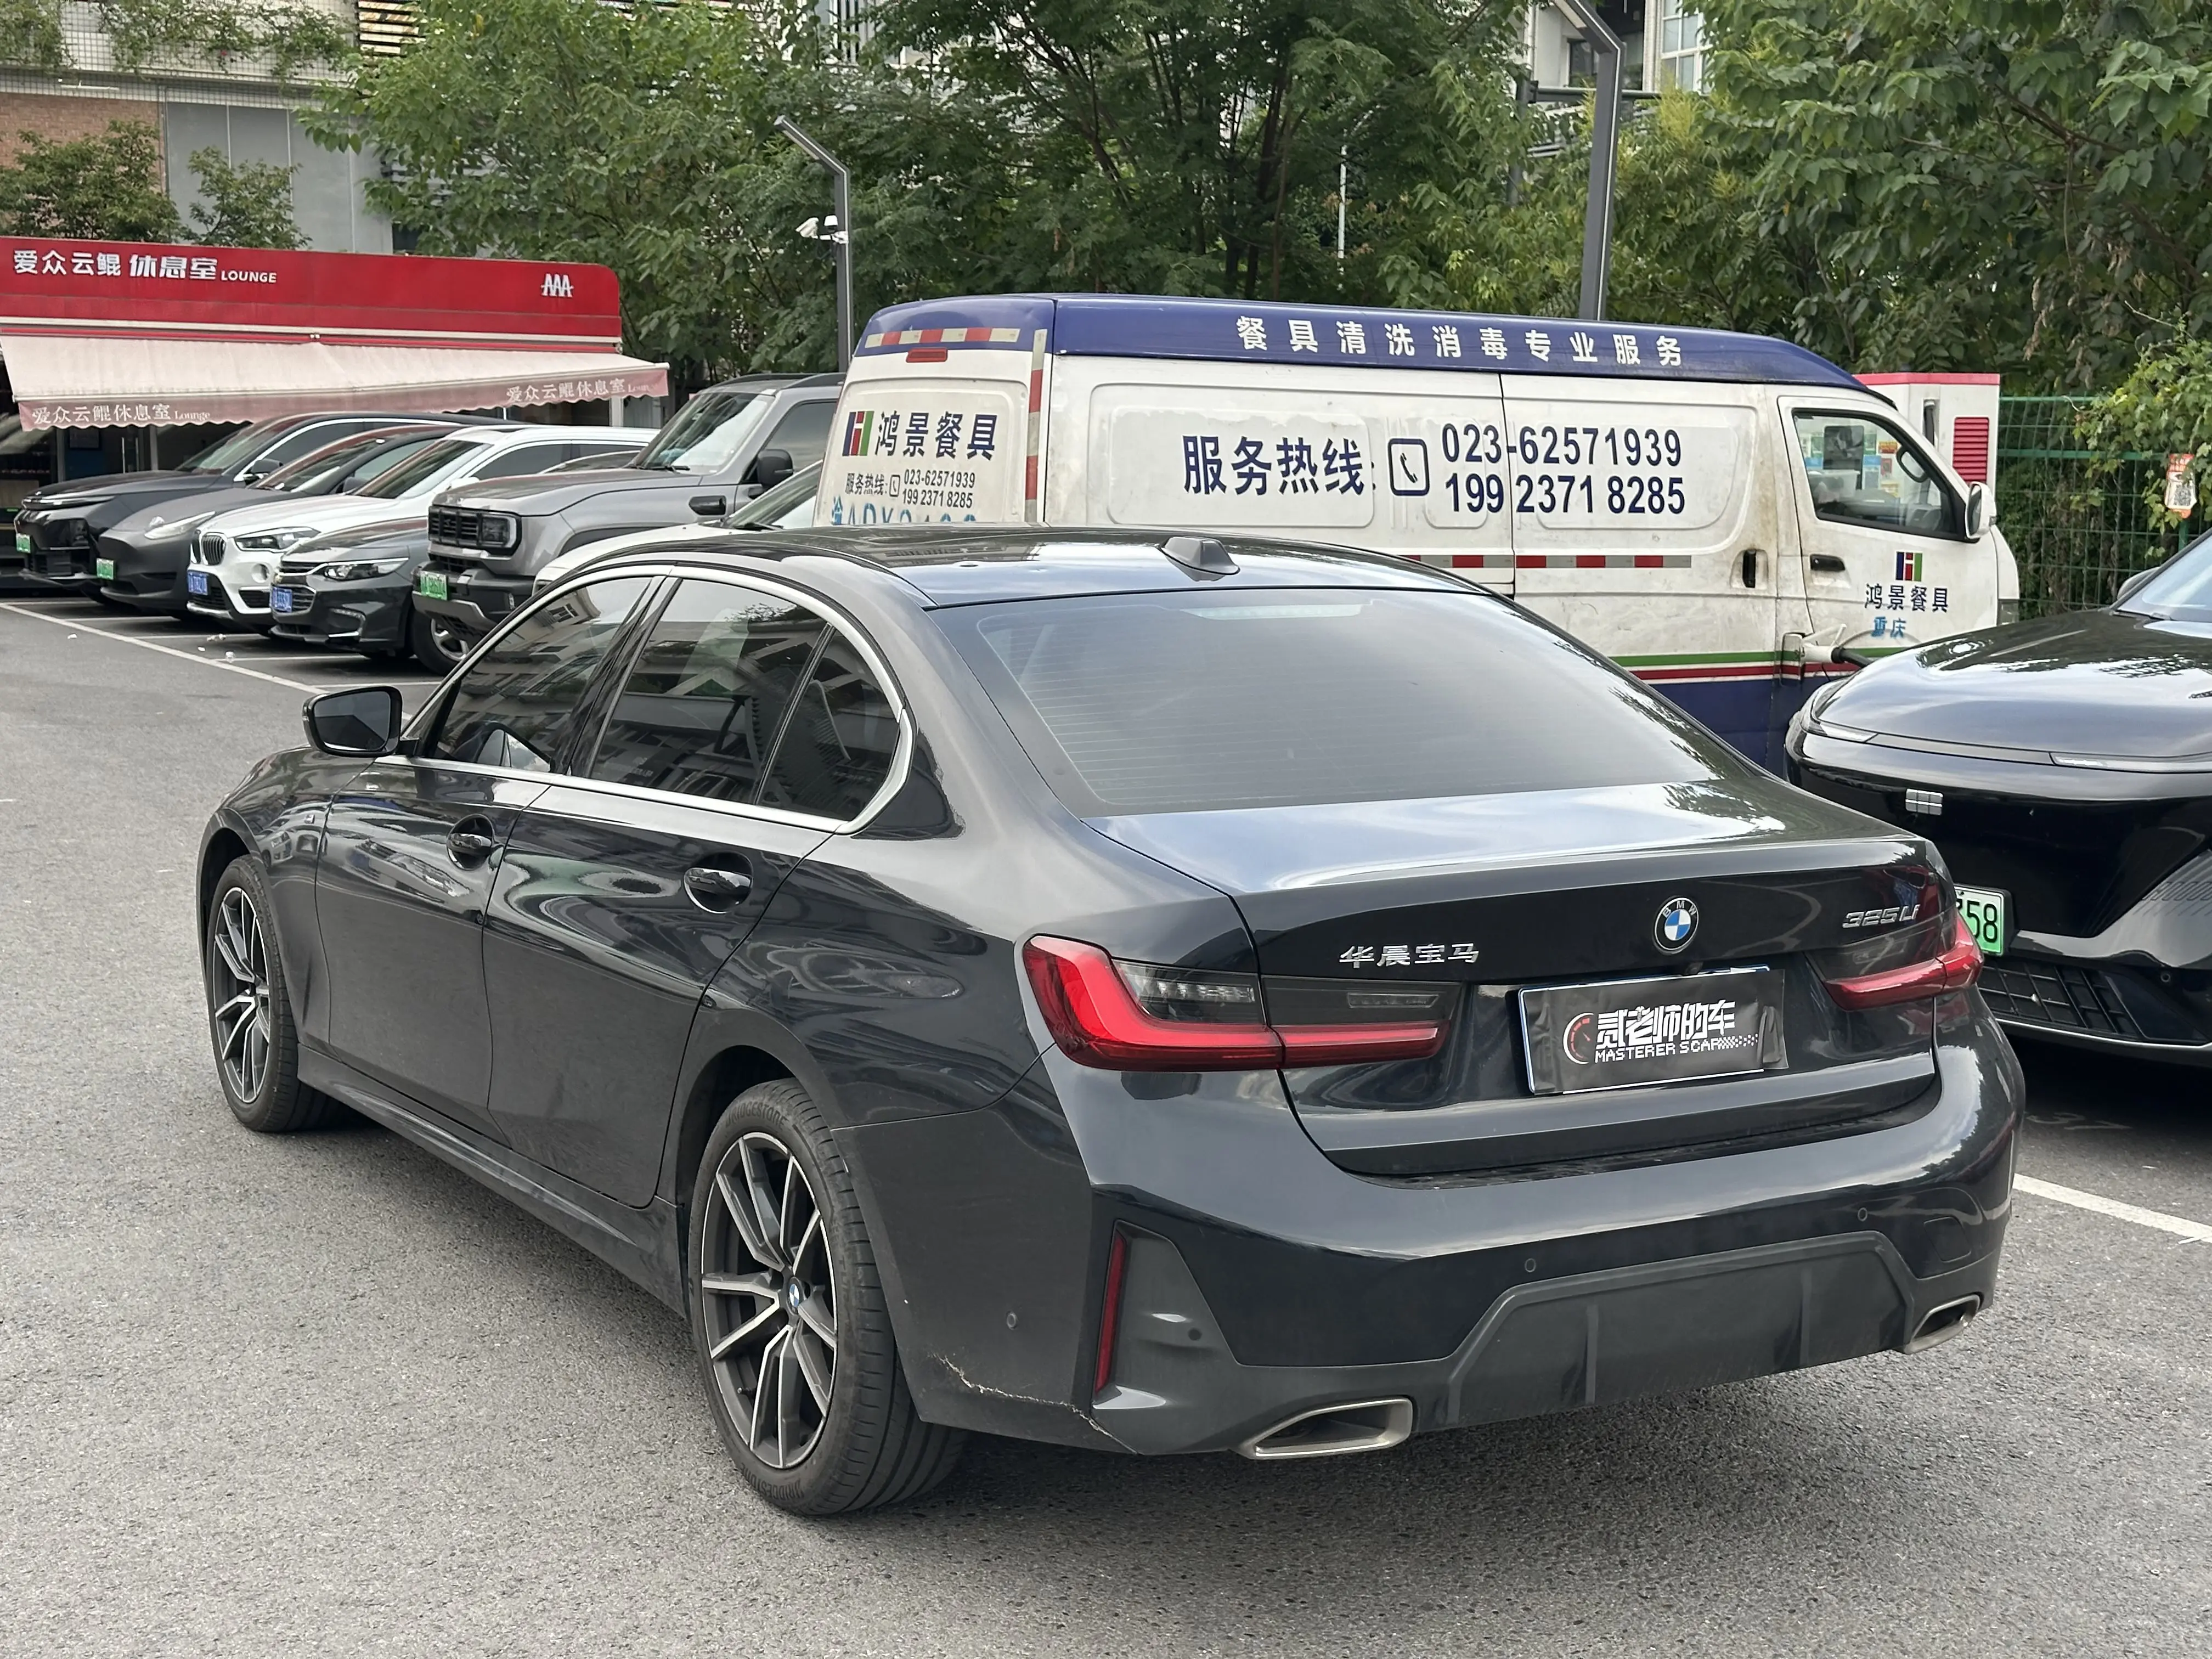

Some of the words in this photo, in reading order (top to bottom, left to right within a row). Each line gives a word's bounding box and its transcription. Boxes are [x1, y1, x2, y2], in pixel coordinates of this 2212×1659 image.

[14, 250, 121, 276] 爱众云鲲
[129, 254, 217, 280] 休息室
[221, 270, 276, 283] LOUNGE
[1236, 316, 1682, 367] 餐具清洗消毒专业服务
[174, 410, 211, 422] Lounge
[875, 410, 997, 460] 鸿景餐具
[1442, 424, 1681, 466] 023-62571939
[904, 469, 975, 488] 023-62571939
[902, 488, 918, 505] 199
[921, 489, 944, 506] 2371
[947, 491, 973, 508] 8285
[1446, 473, 1503, 513] 199
[1516, 475, 1593, 513] 2371
[1608, 476, 1685, 514] 8285
[1864, 583, 1949, 613] 鸿景餐具
[1871, 616, 1906, 638] 重庆
[1662, 900, 1696, 917] BMW
[1842, 904, 1921, 928] 325Li
[1956, 899, 1997, 943] 58
[1339, 943, 1479, 968] 华晨宝马
